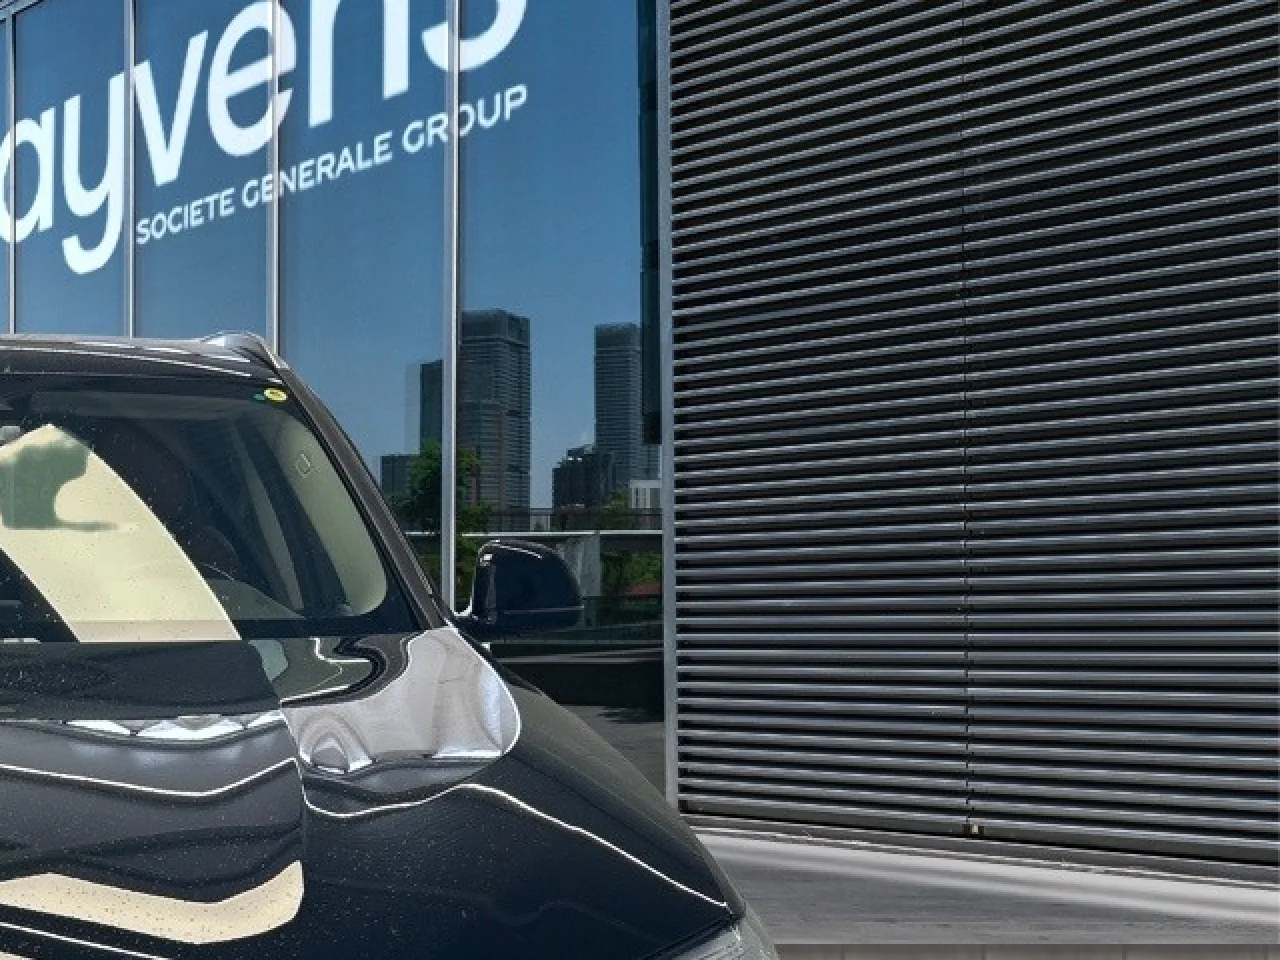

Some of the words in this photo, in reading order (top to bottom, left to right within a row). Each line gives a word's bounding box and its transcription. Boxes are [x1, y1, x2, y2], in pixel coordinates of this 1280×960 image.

[135, 188, 235, 244] SOCIETE
[242, 131, 392, 208] GENERALE
[402, 84, 528, 154] GROUP
